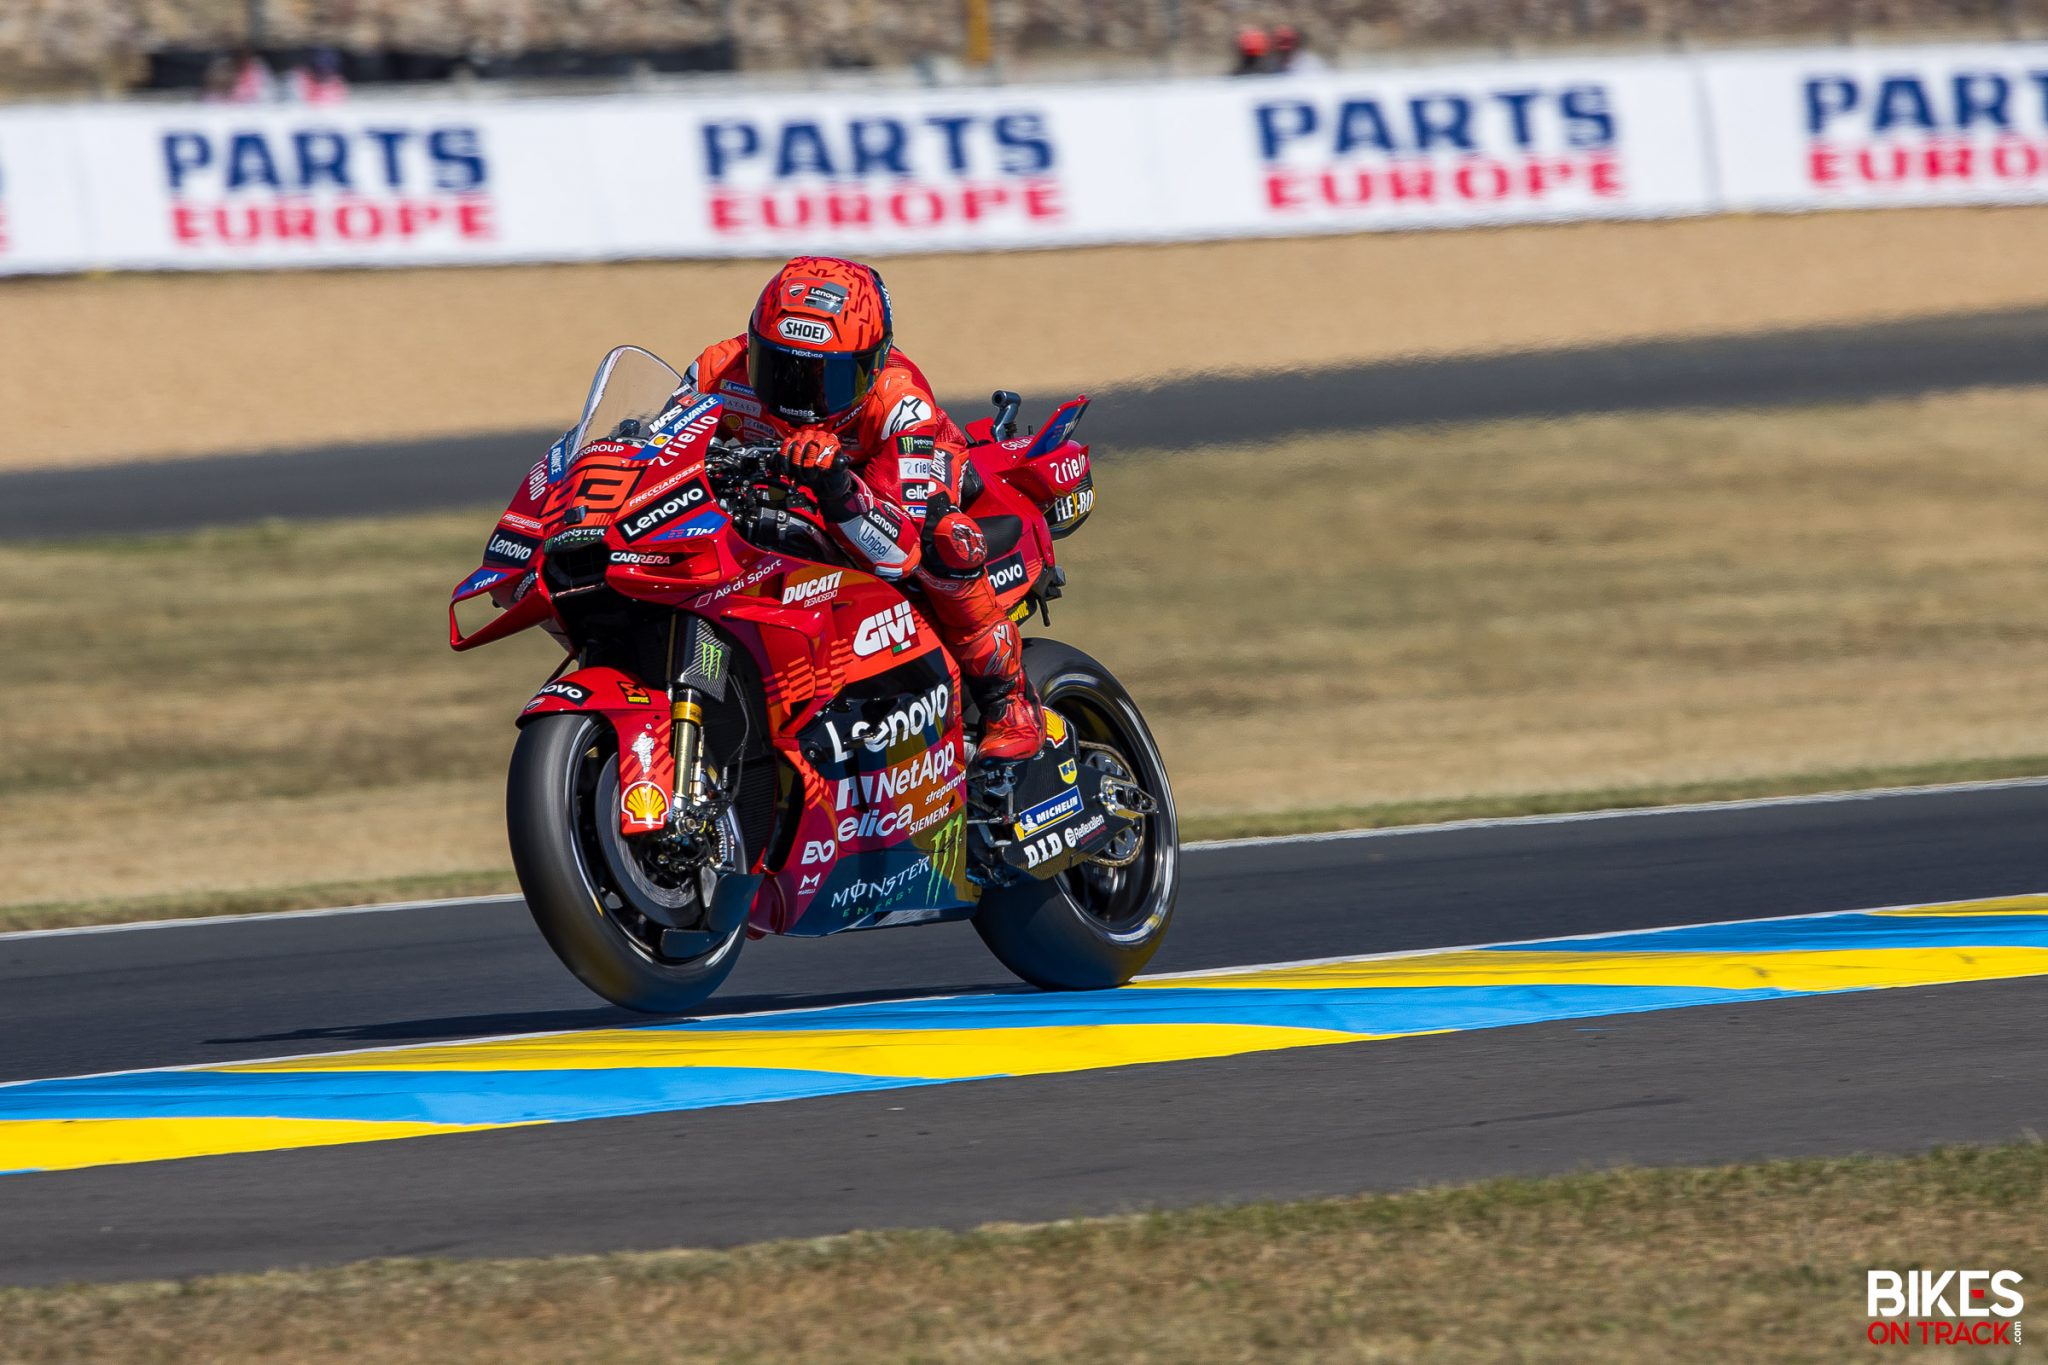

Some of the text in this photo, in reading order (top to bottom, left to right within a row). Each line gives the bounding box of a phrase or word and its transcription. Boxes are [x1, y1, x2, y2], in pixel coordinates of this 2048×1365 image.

[1252, 85, 1618, 161] PARTS
[160, 126, 488, 193] PARTS
[700, 112, 1056, 181] PARTS
[1264, 152, 1624, 210] EUROPE
[170, 198, 495, 244] EUROPE
[708, 178, 1064, 233] EUROPE
[785, 321, 825, 341] SHOEI
[648, 404, 683, 433] WRS
[673, 396, 719, 434] ADVANCE
[628, 463, 702, 507] FRECCIAROSSA
[905, 485, 929, 500] elic
[622, 486, 704, 538] Lenovo
[868, 511, 899, 538] Lenovo
[488, 533, 533, 560] Lenovo
[686, 526, 716, 536] TIM
[861, 526, 892, 558] Unipol
[610, 551, 672, 565] CARRERA
[747, 559, 783, 585] Sport
[473, 573, 499, 590] TIM
[781, 571, 844, 606] DUCATI
[988, 563, 1024, 589] novo
[853, 600, 918, 657] GIVI
[825, 683, 949, 764] Lenovo
[874, 741, 956, 804] NetApp
[837, 803, 914, 843] elica
[908, 803, 951, 836] SIEMENS
[1036, 796, 1079, 825] MICHELIN
